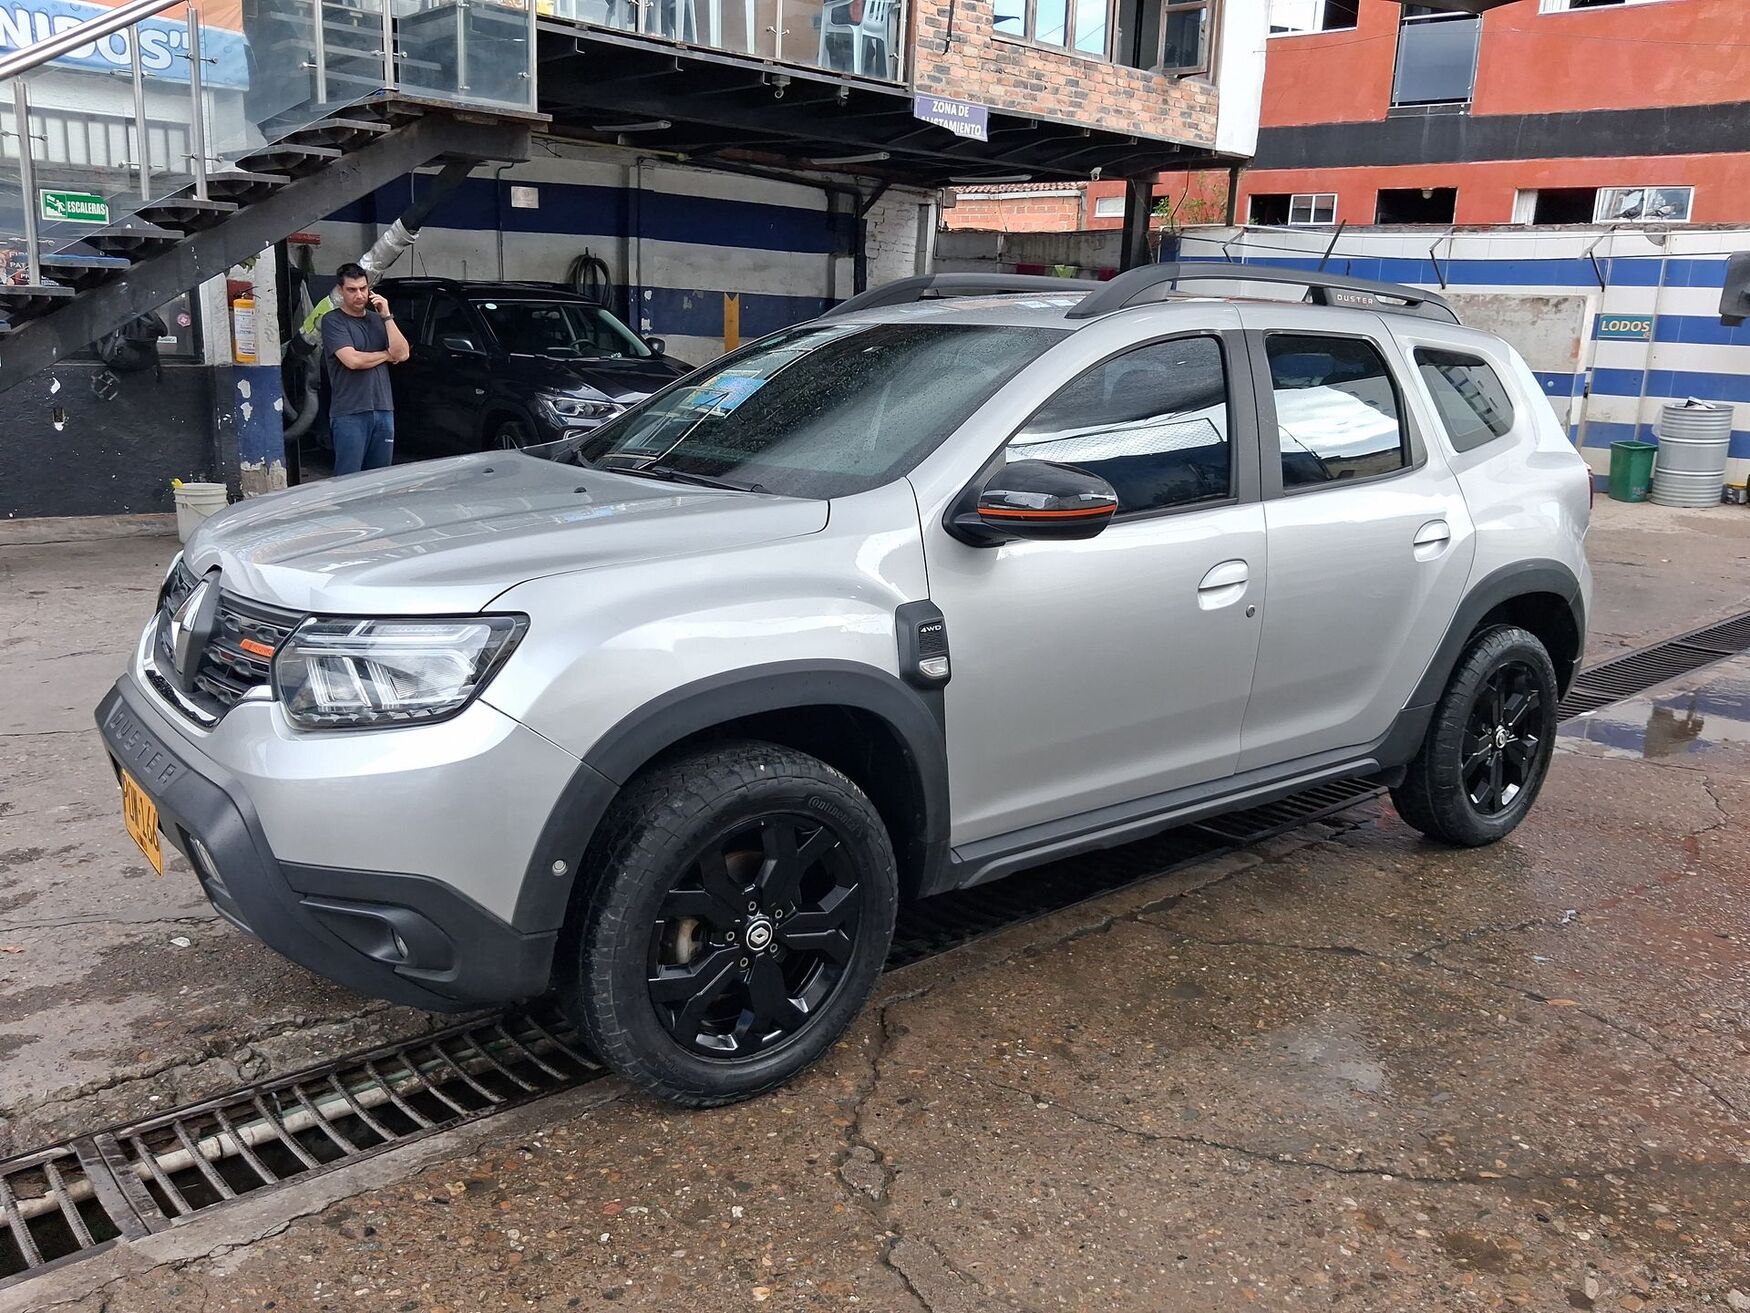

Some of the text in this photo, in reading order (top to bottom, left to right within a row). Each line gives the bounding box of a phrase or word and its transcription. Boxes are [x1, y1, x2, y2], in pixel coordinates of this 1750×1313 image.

[932, 101, 970, 118] ZONA DE
[67, 201, 106, 215] ESCALERAS
[1336, 294, 1374, 305] DUSTER
[1601, 320, 1651, 332] LODOS
[920, 624, 942, 633] 4WD
[109, 710, 177, 785] DUSTER
